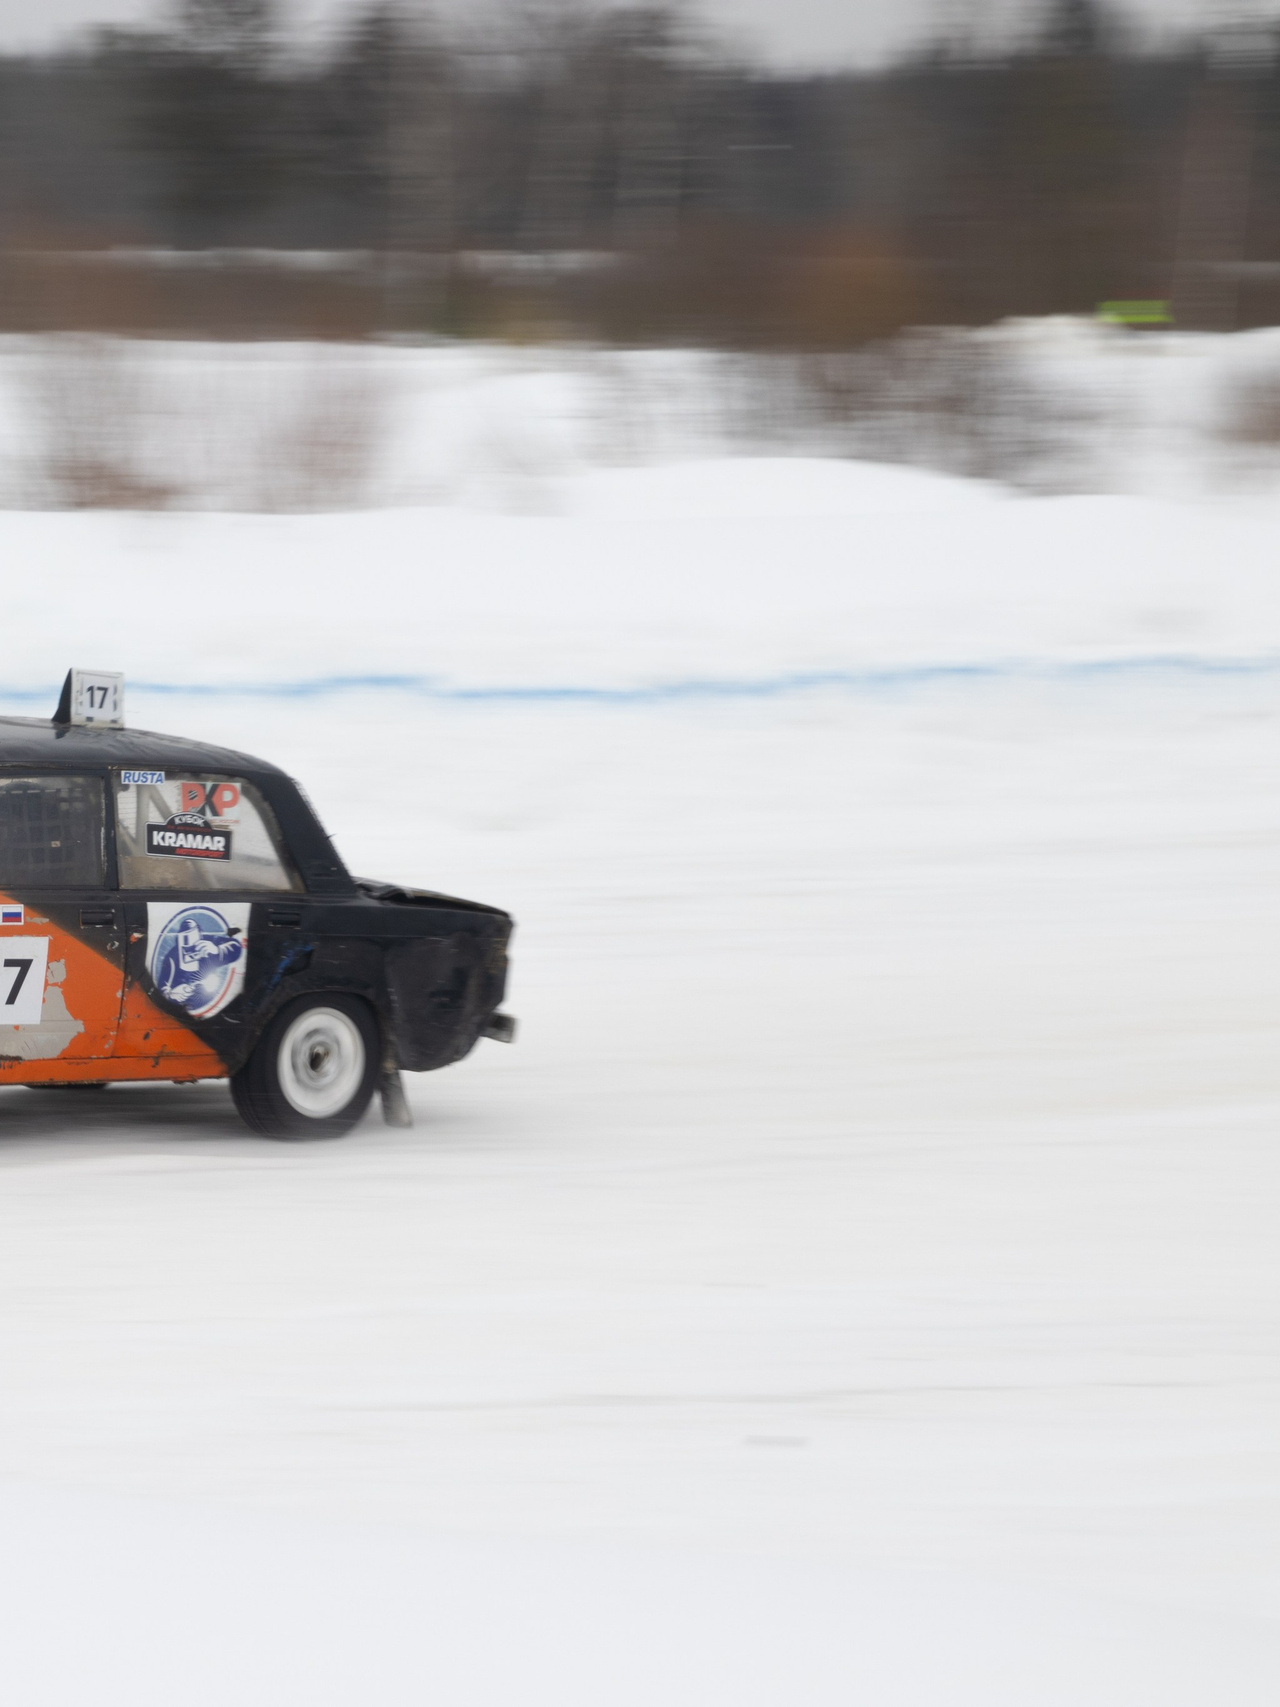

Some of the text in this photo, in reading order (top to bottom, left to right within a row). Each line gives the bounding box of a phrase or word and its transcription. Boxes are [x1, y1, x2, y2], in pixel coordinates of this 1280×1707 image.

[86, 685, 110, 709] 17
[122, 771, 165, 784] RUSTA
[173, 814, 205, 827] КУБОК
[152, 830, 226, 852] KRAMAR
